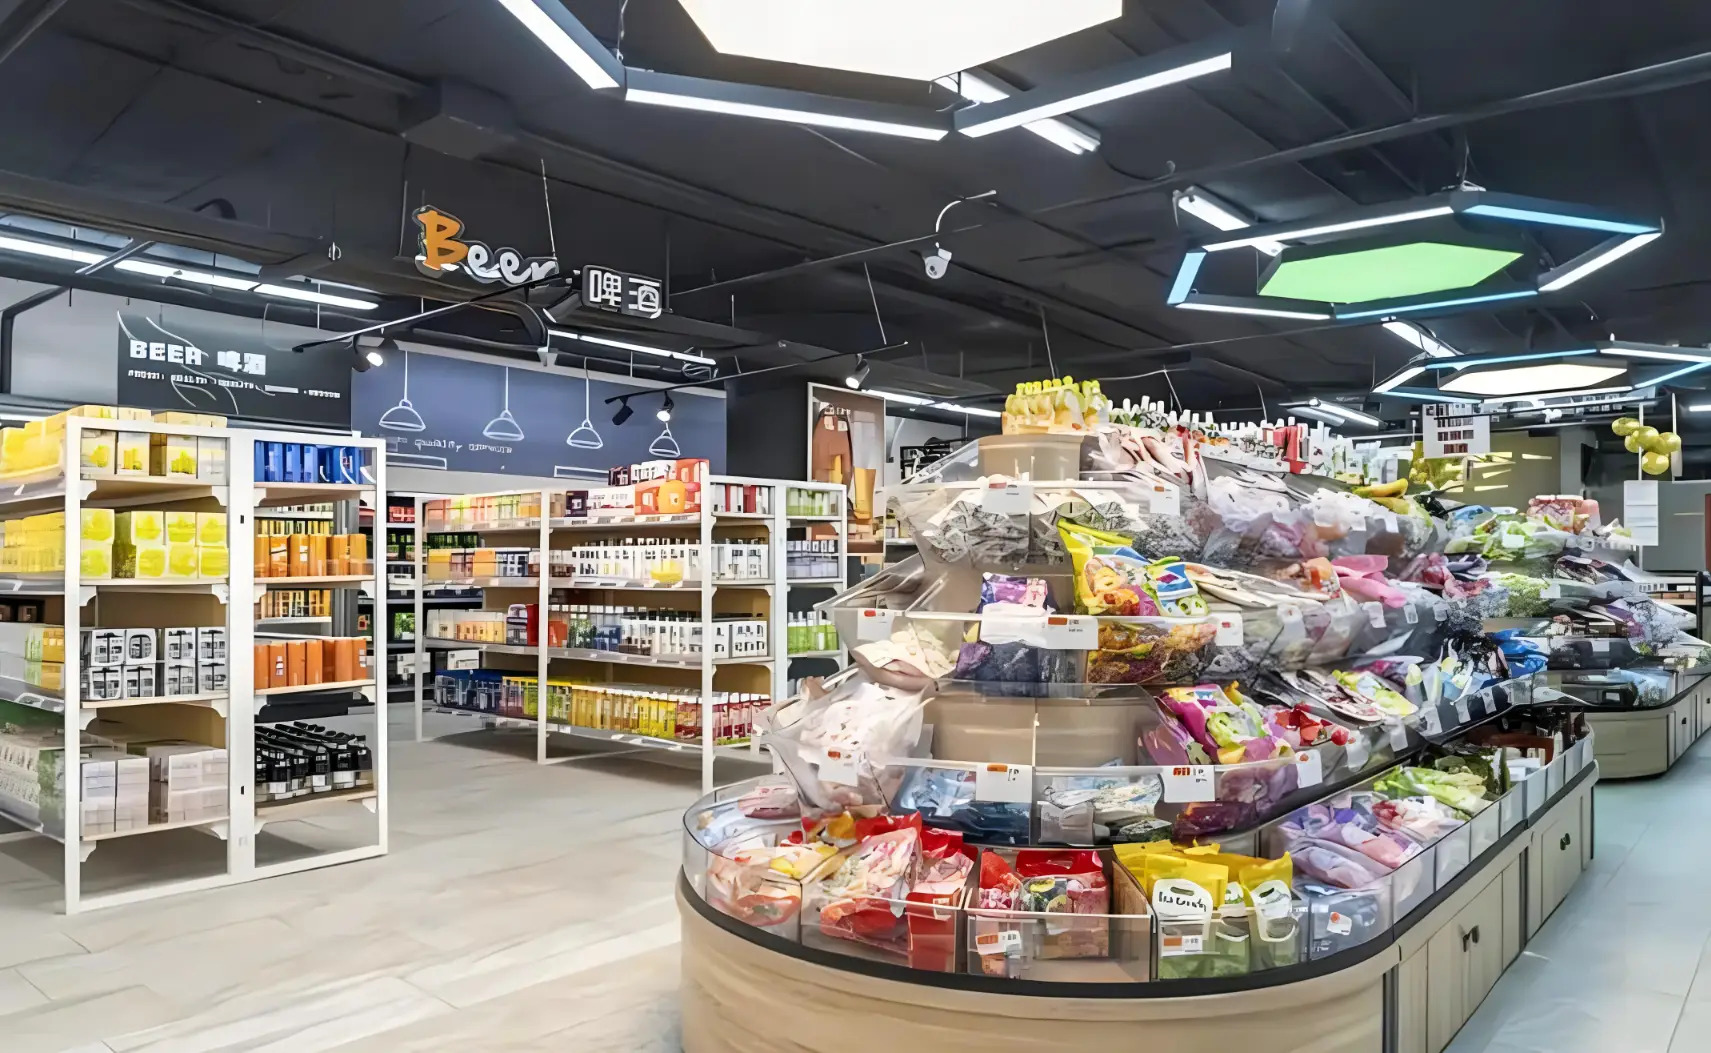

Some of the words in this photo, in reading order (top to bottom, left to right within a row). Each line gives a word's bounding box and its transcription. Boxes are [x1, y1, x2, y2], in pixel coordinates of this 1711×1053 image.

[417, 210, 557, 284] Beer
[589, 269, 661, 318] 啤酒
[130, 340, 202, 366] BEER
